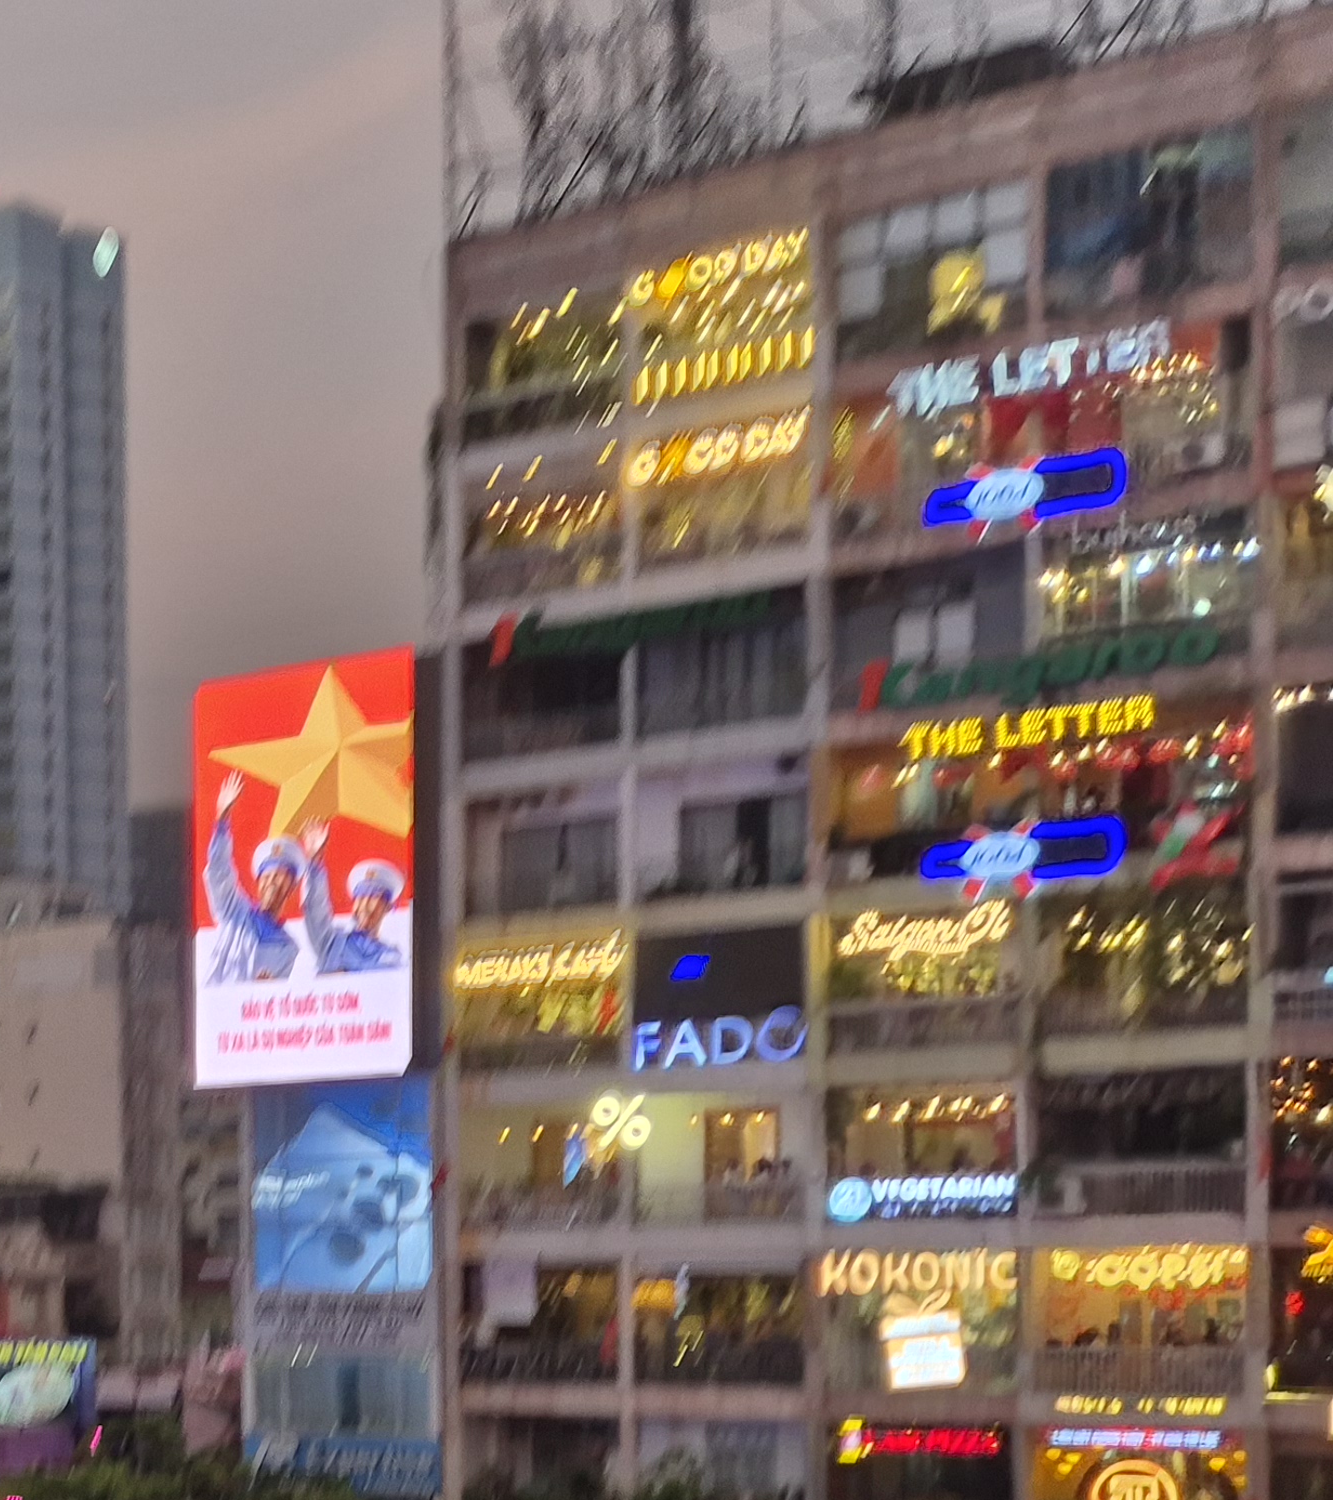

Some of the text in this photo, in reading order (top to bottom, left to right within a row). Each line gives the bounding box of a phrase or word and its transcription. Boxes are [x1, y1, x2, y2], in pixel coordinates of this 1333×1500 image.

[898, 693, 1158, 763] THE LETTER
[635, 1004, 809, 1071] FADO
[870, 1173, 1018, 1204] VEGETARIAN
[816, 1247, 1019, 1298] KOKONIC
